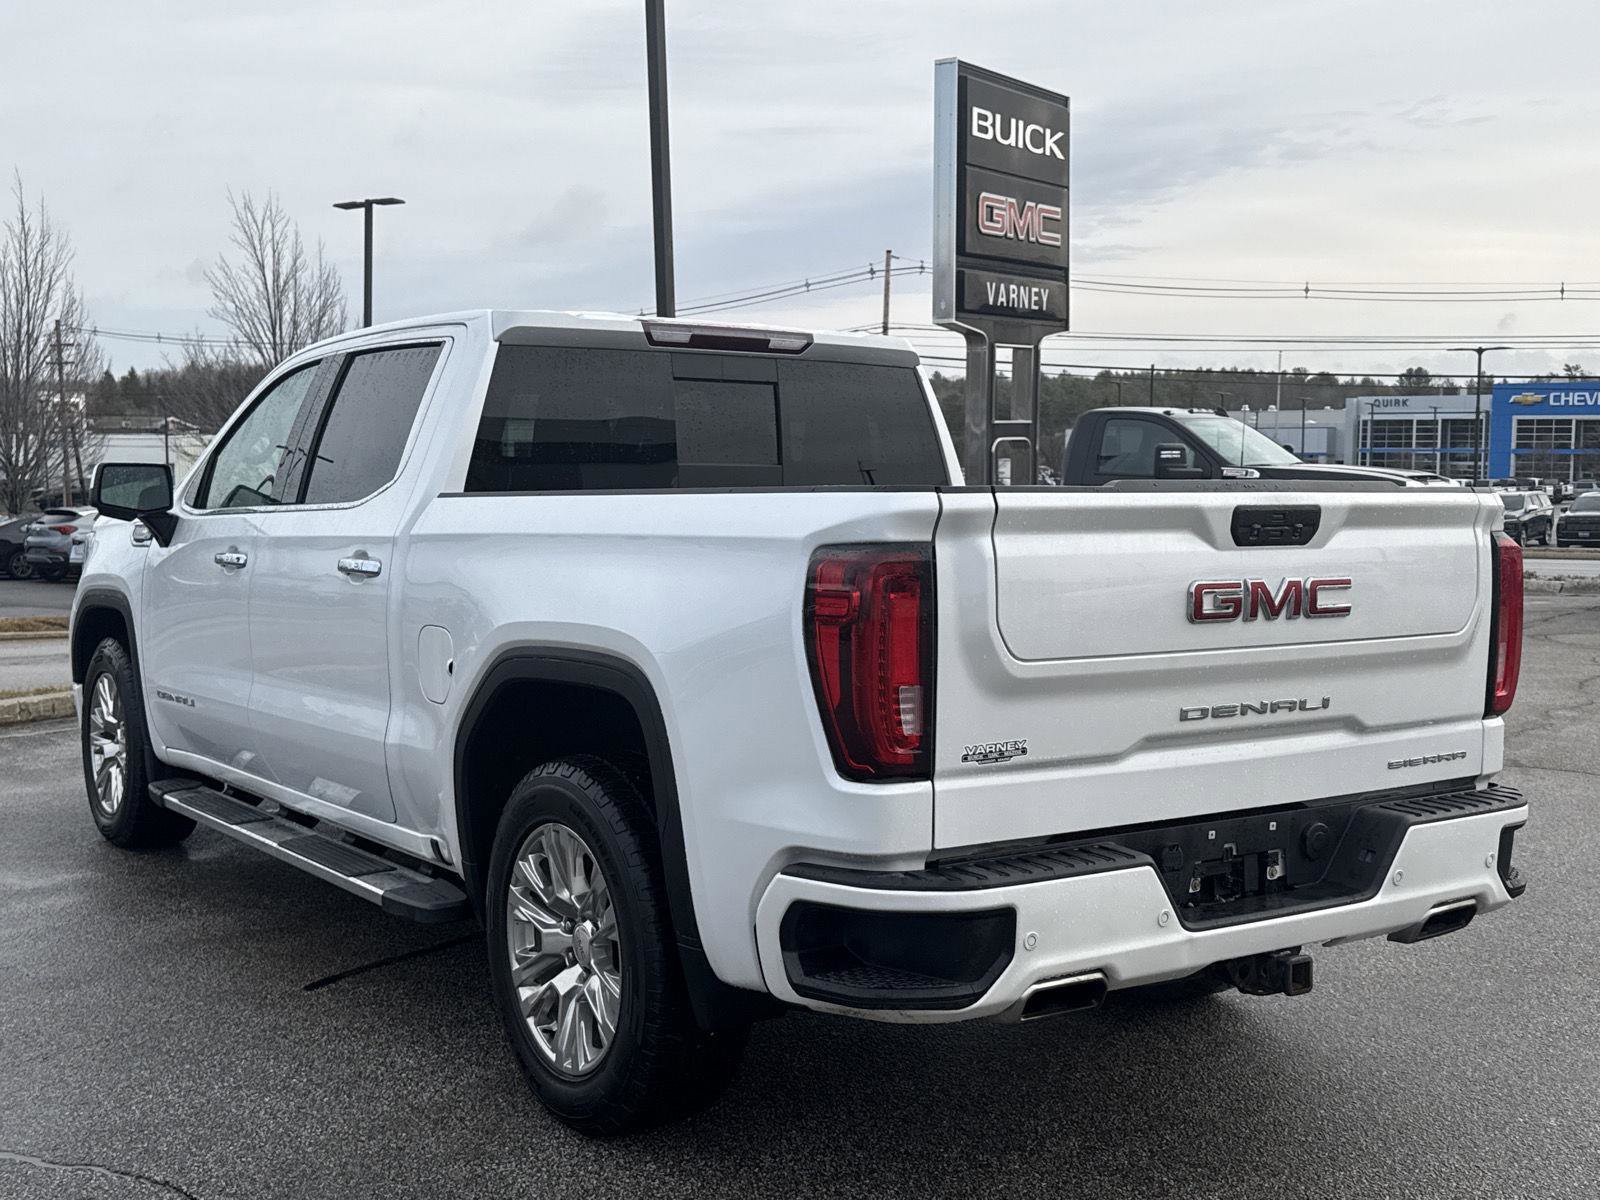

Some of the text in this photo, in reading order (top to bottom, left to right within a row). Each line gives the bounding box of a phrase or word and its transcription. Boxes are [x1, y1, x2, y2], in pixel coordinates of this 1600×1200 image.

[971, 106, 1065, 160] BUICK
[978, 191, 1062, 247] GMC
[986, 281, 1049, 311] VARNEY
[1373, 398, 1409, 408] QUIRK
[1549, 391, 1600, 406] CHEV
[1187, 577, 1352, 624] GMC
[1180, 696, 1331, 722] DENALI
[964, 739, 1027, 755] VARNEY
[1387, 750, 1467, 770] SIERRA
